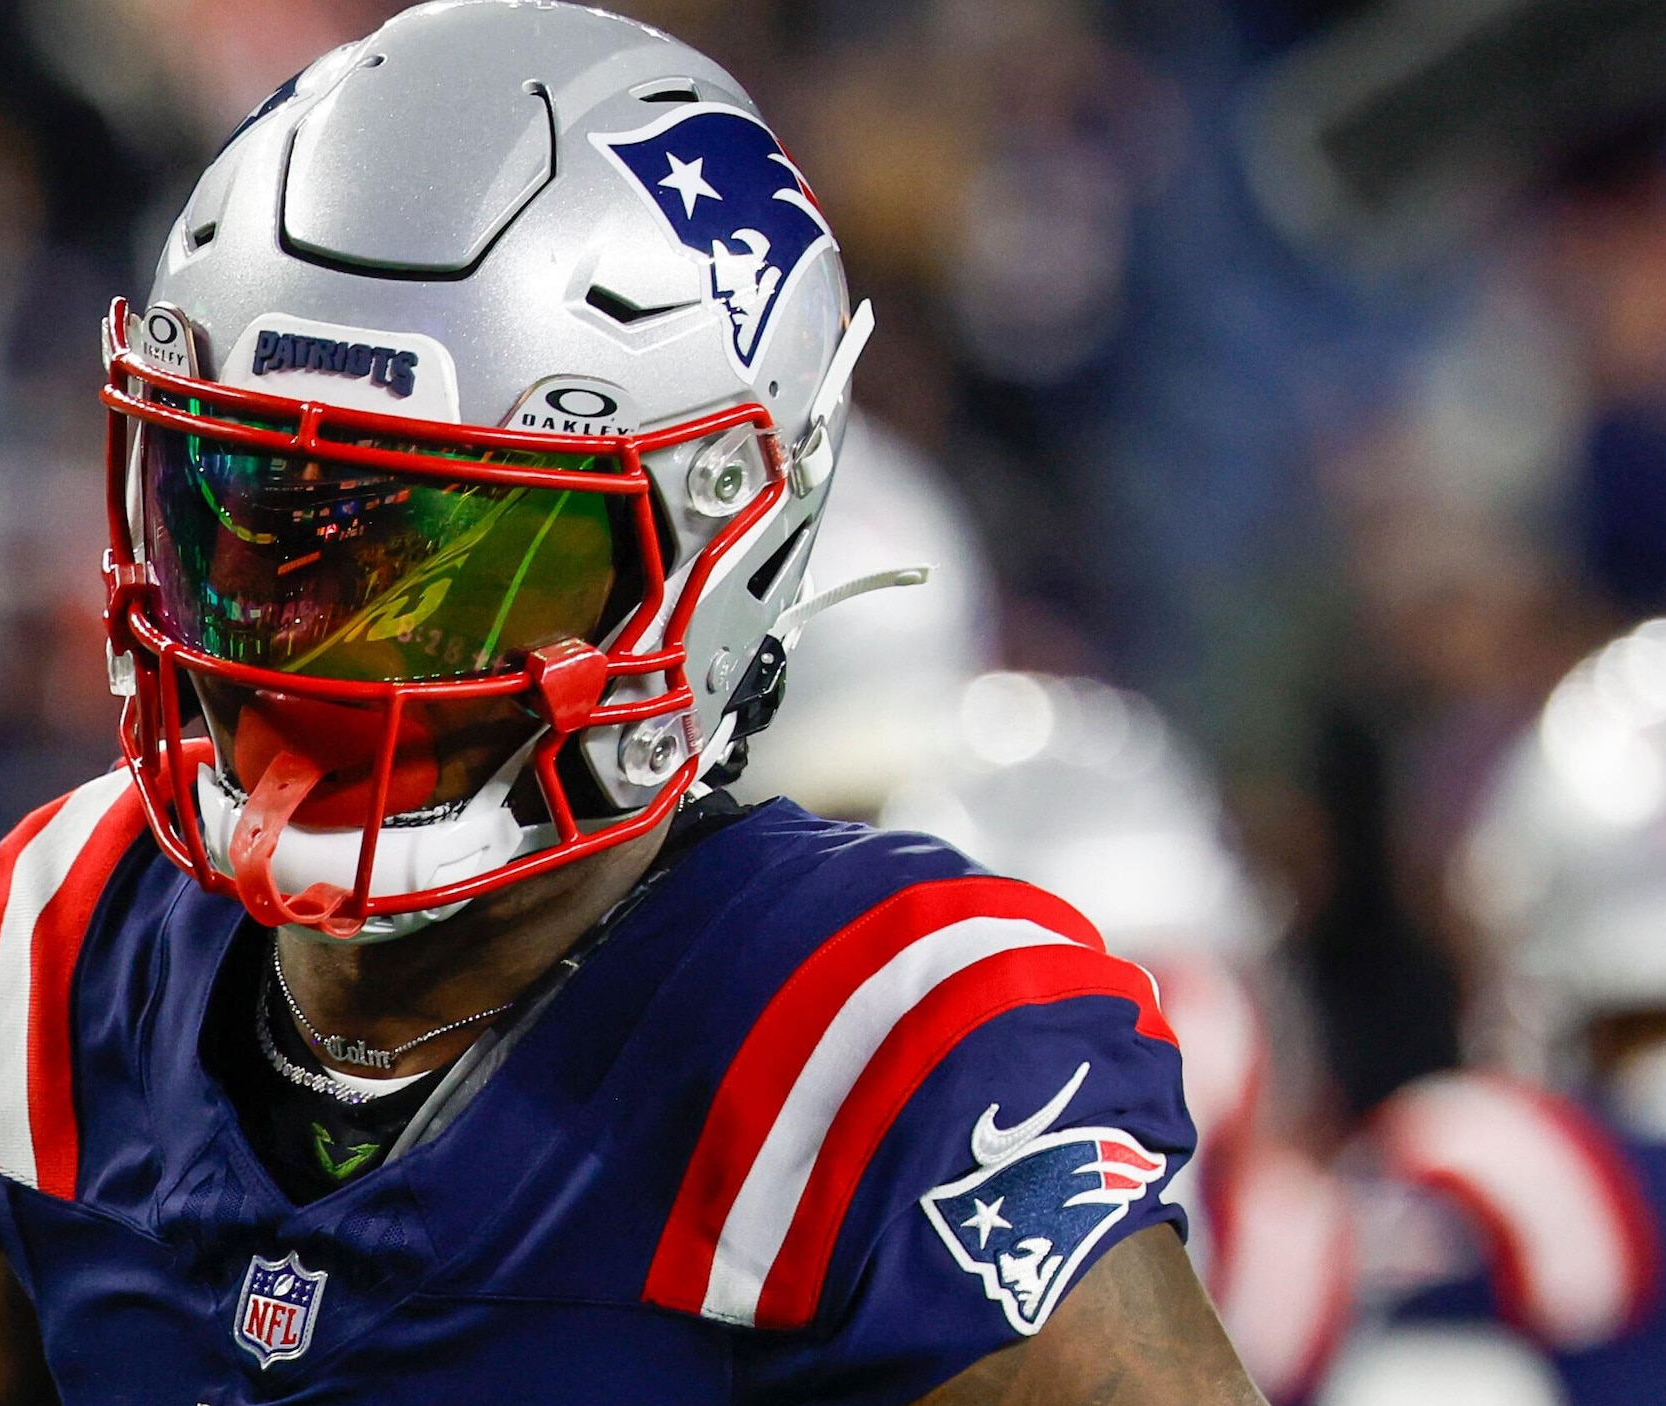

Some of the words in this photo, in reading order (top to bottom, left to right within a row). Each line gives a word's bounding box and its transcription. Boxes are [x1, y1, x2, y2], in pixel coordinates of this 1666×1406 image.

[252, 330, 419, 398] PATRIOTS
[521, 413, 630, 436] OAKLEY
[244, 1298, 298, 1348] NFL
